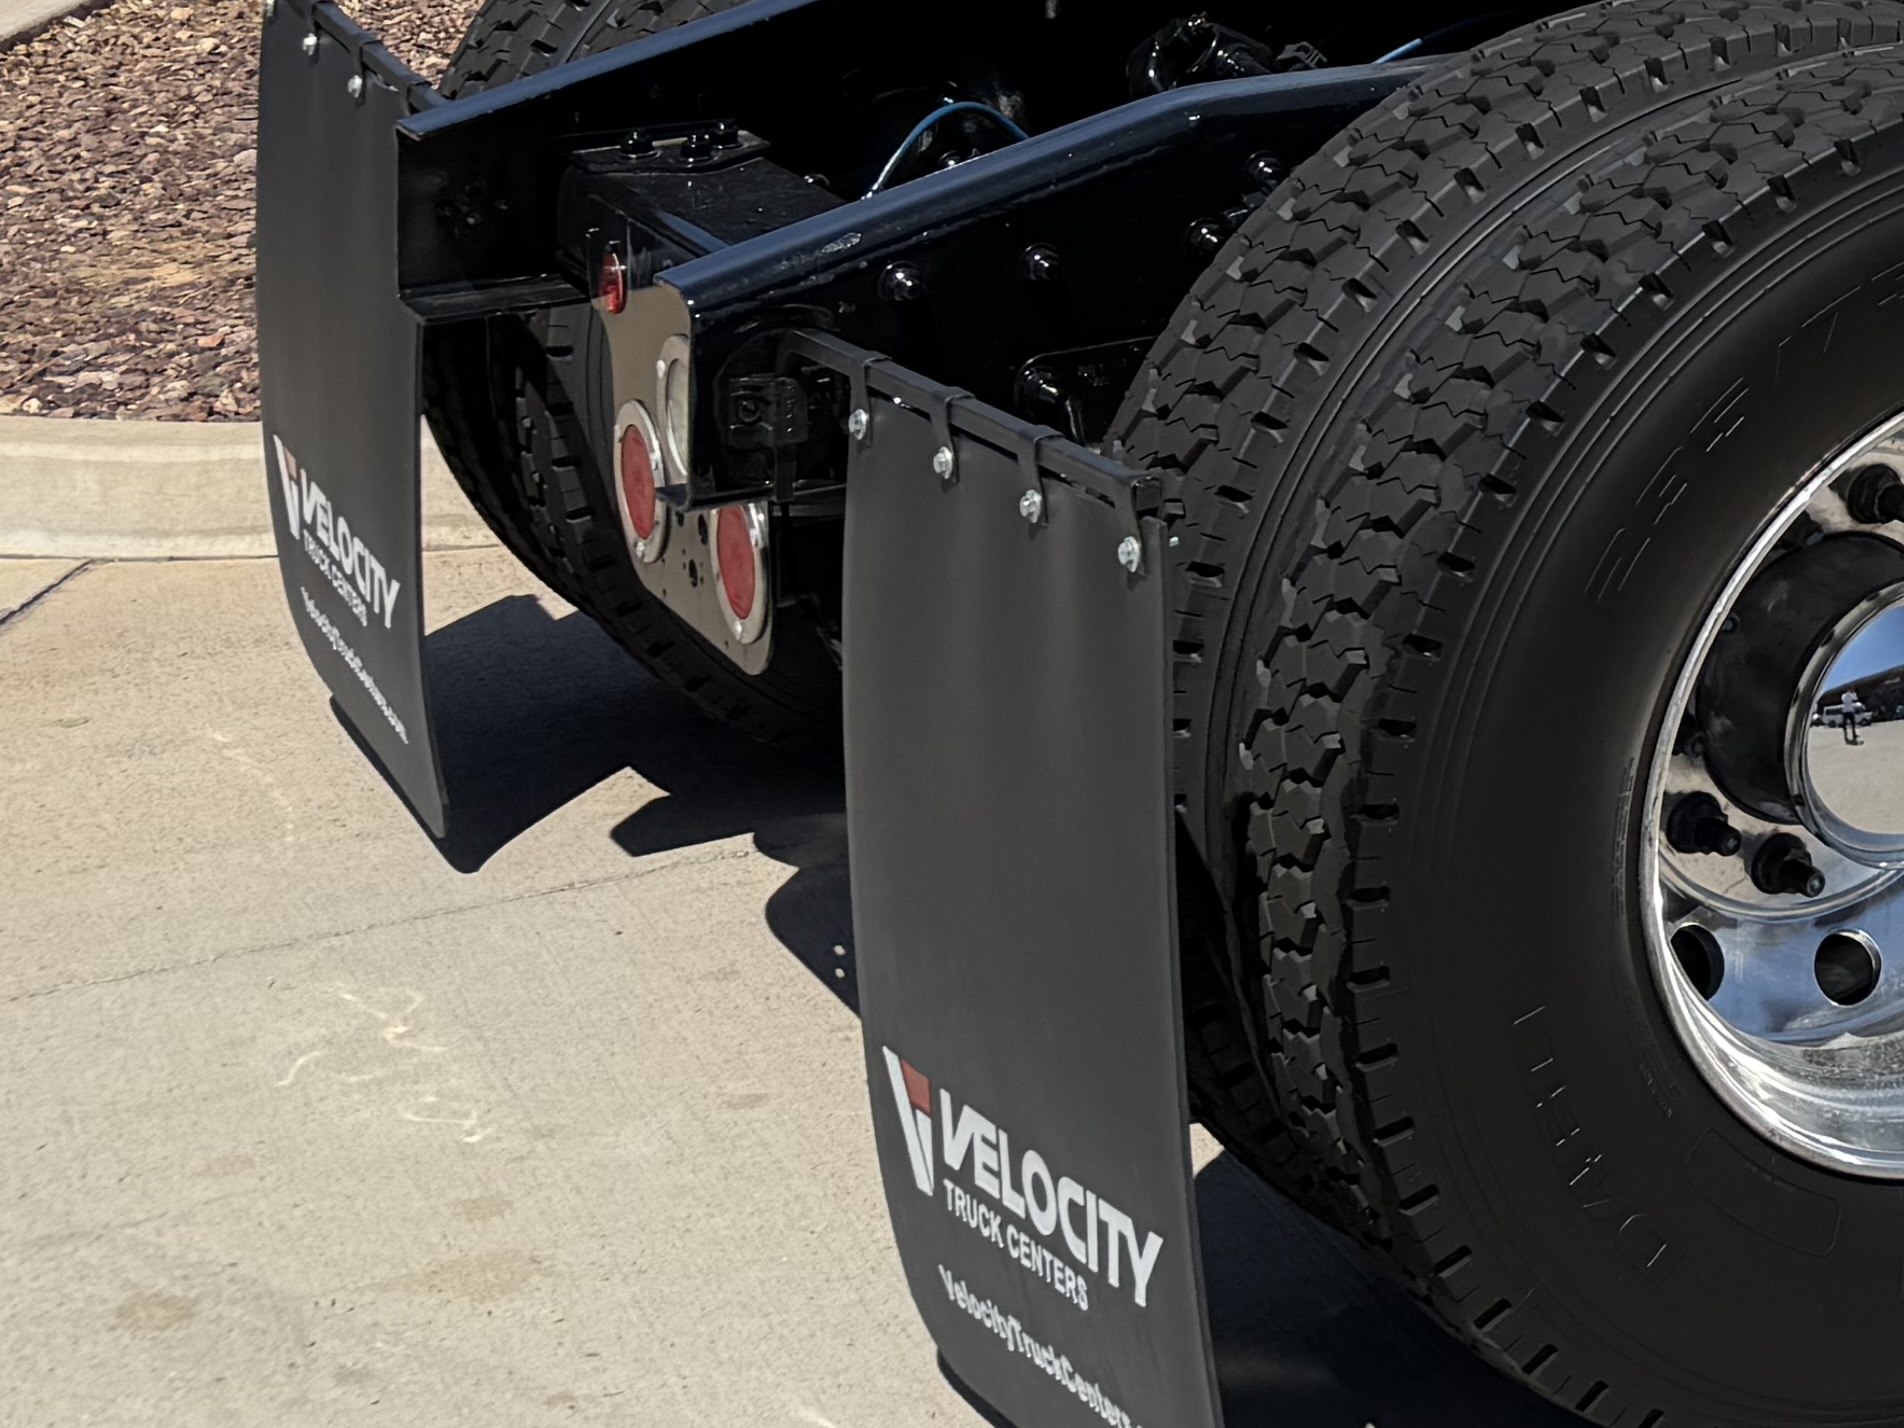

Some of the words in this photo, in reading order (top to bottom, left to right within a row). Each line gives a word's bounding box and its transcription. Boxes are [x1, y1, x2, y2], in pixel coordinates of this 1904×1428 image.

[300, 467, 401, 629] VELOCITY
[939, 1088, 1164, 1308] VELOCITY
[943, 1178, 1005, 1249] TRUCK
[1006, 1236, 1089, 1312] CENTERS
[937, 1263, 1143, 1428] VelocityTruckCenters
